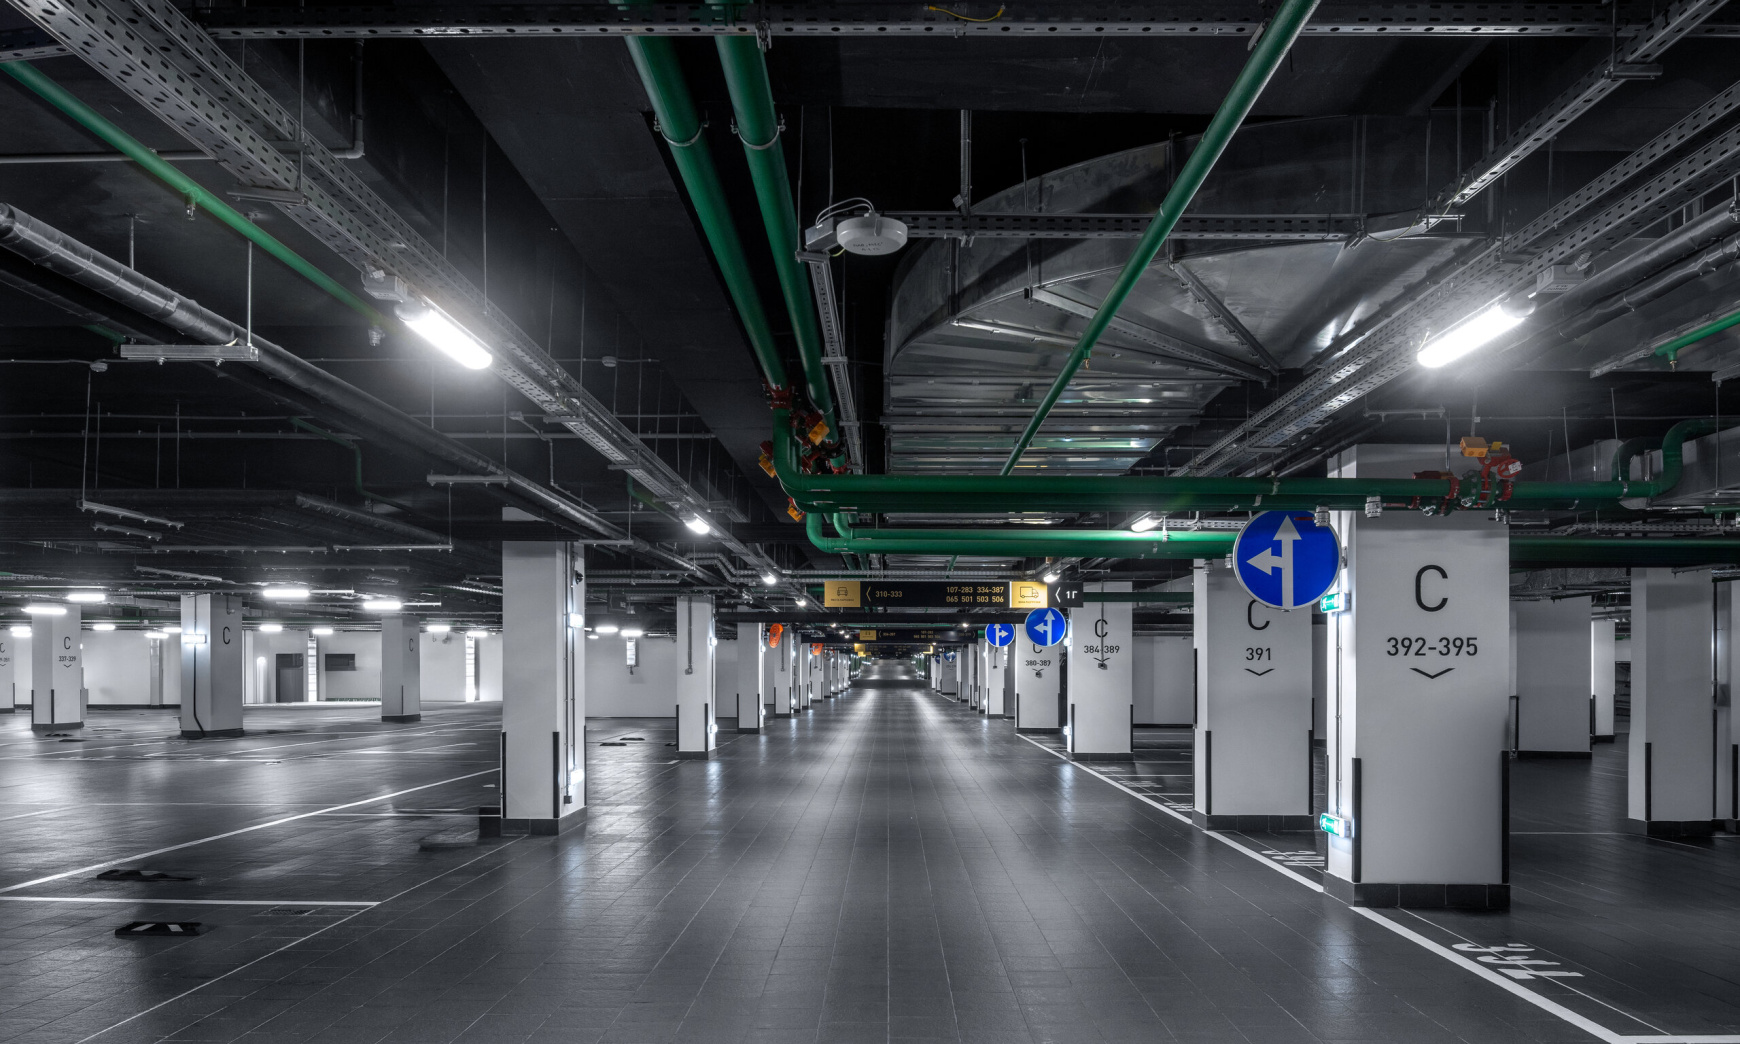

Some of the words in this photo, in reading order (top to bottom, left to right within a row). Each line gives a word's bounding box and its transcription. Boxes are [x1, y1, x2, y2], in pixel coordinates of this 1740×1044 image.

[875, 590, 902, 598] 310-333
[1415, 565, 1449, 612] C
[946, 595, 959, 603] 065
[961, 595, 973, 603] 501
[976, 595, 988, 603] 503
[991, 595, 1004, 603] 506
[222, 626, 231, 645] C
[63, 636, 71, 650] C
[1386, 637, 1478, 656] 392-395
[1246, 647, 1271, 661] 391
